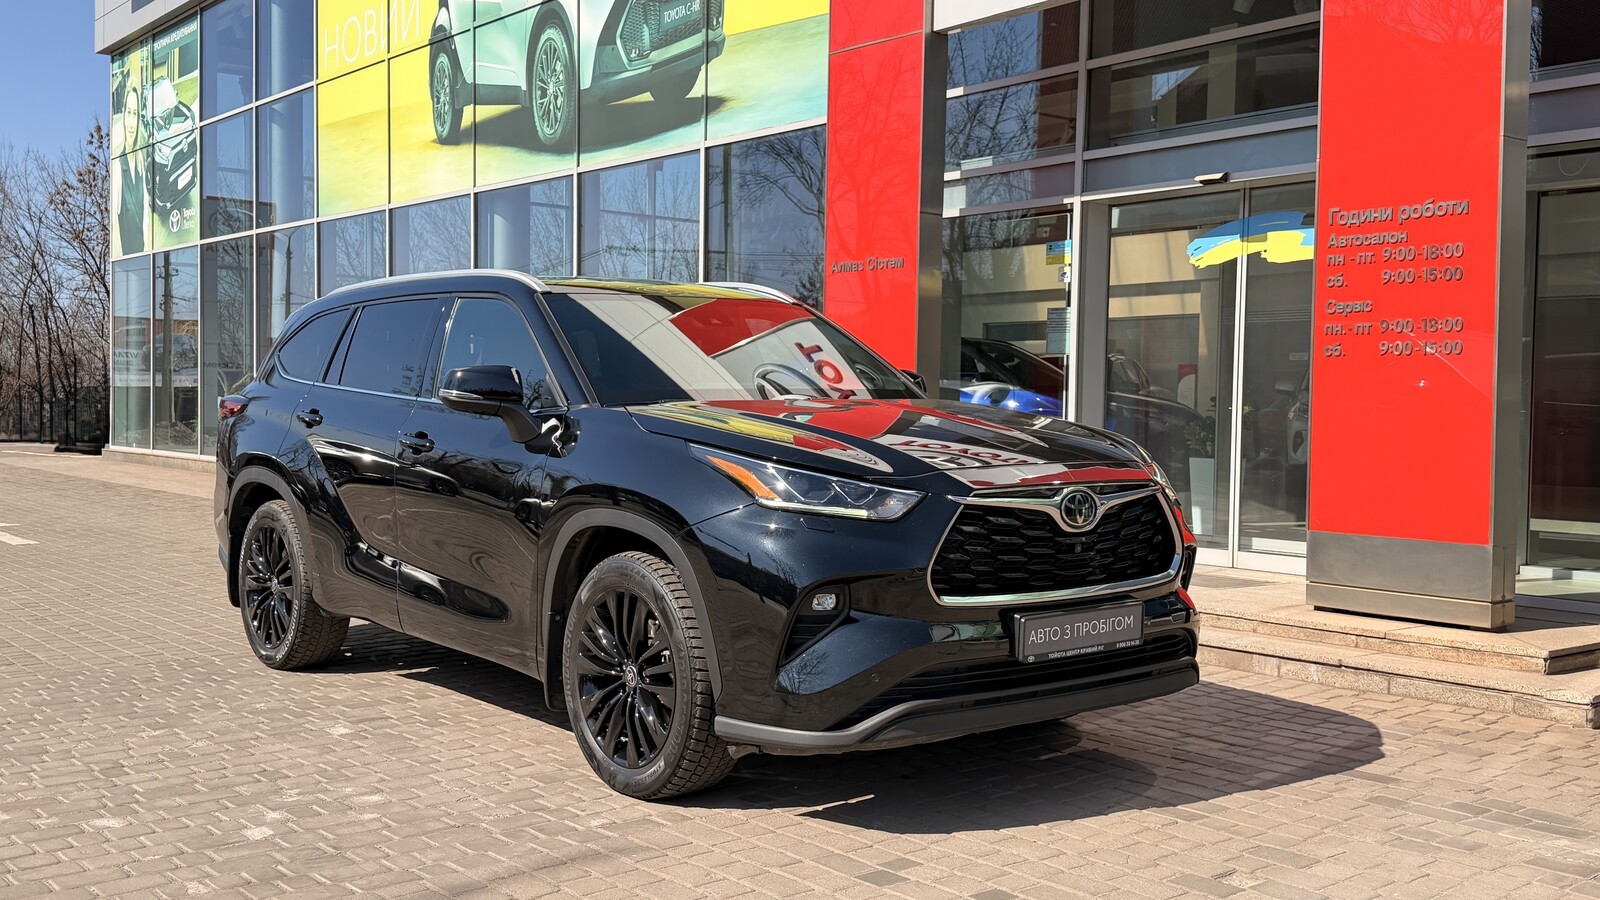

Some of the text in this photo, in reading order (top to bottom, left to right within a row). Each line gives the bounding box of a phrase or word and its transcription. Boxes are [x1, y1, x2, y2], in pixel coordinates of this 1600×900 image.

[663, 0, 701, 23] TOYOTA C-HR
[1328, 199, 1470, 228] Години роботи
[1327, 231, 1408, 248] Автосалон
[831, 256, 905, 274] Алмаз Сістем
[1326, 272, 1348, 288] сб.
[1325, 299, 1373, 316] Сервіс
[1324, 343, 1346, 357] сб.
[1028, 626, 1061, 645] АВТО
[1074, 615, 1134, 637] ПРОБІГОМ
